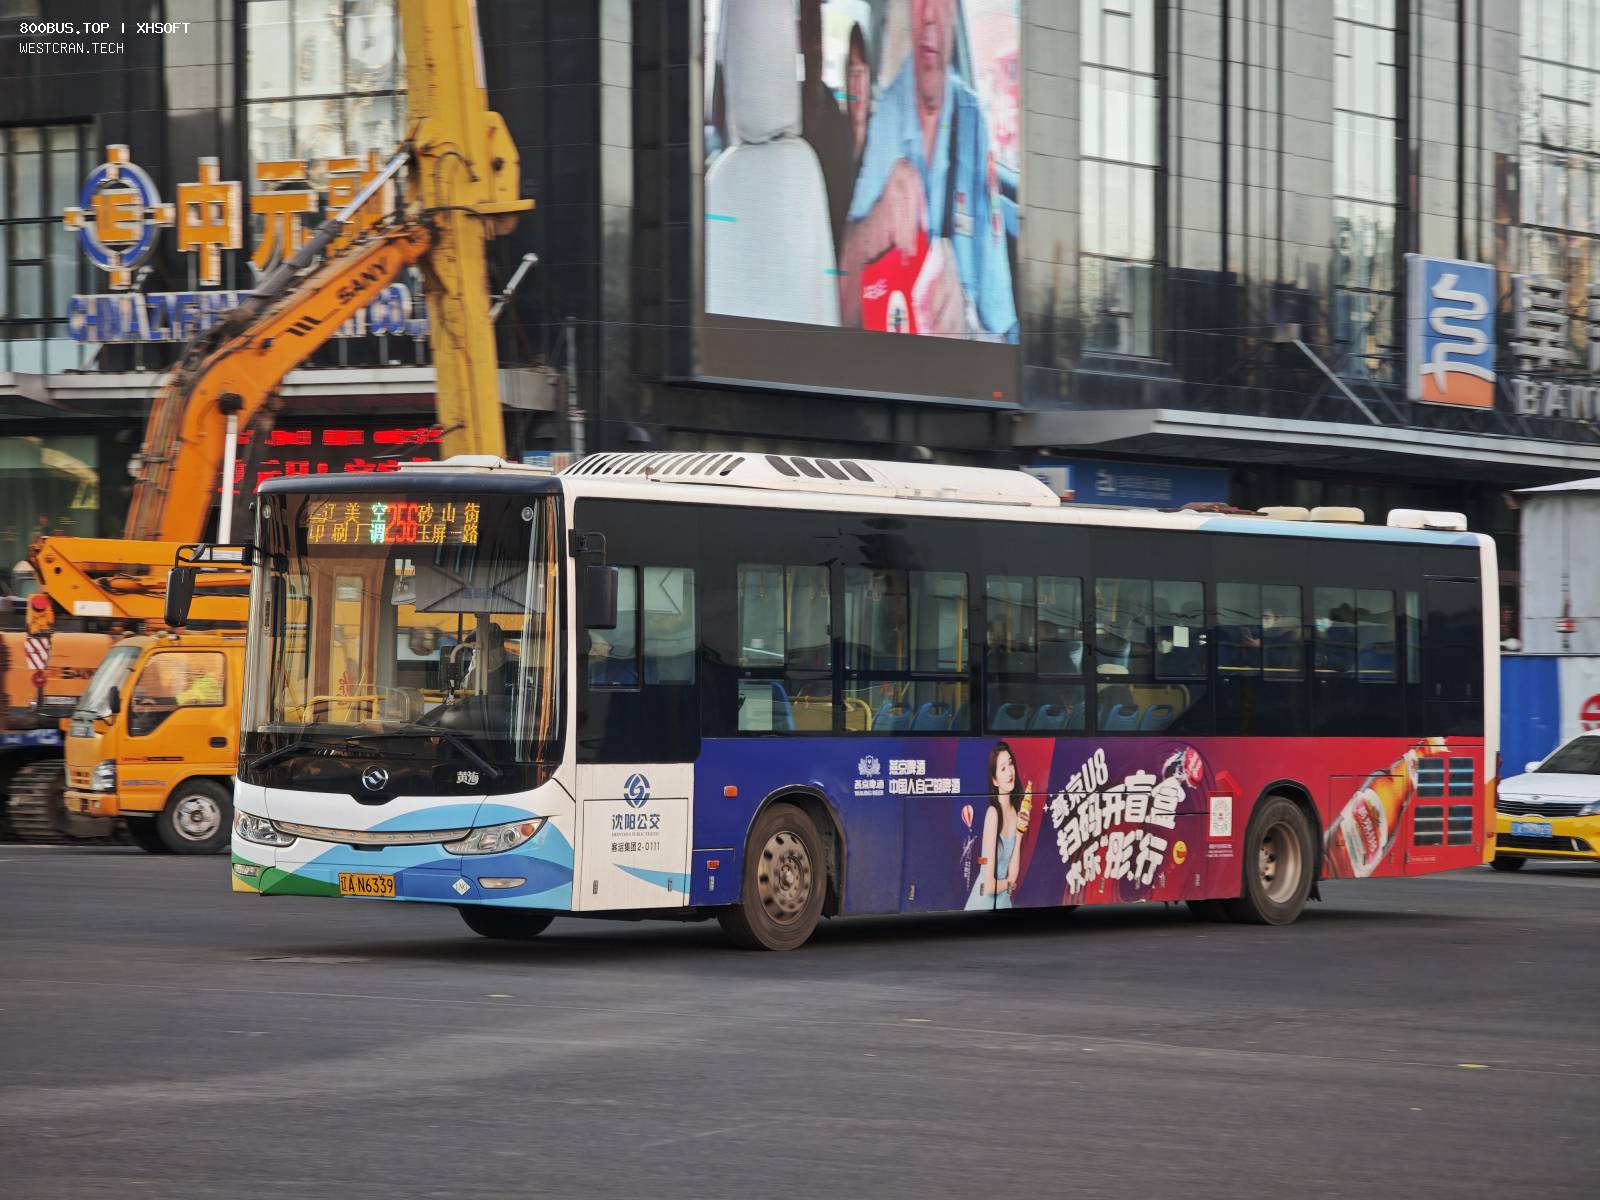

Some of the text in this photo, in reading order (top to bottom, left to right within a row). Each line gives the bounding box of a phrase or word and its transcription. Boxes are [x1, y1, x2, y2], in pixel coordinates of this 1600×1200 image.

[336, 257, 389, 305] SANY
[455, 770, 480, 786] 黄海
[611, 813, 661, 831] 沈阳公交
